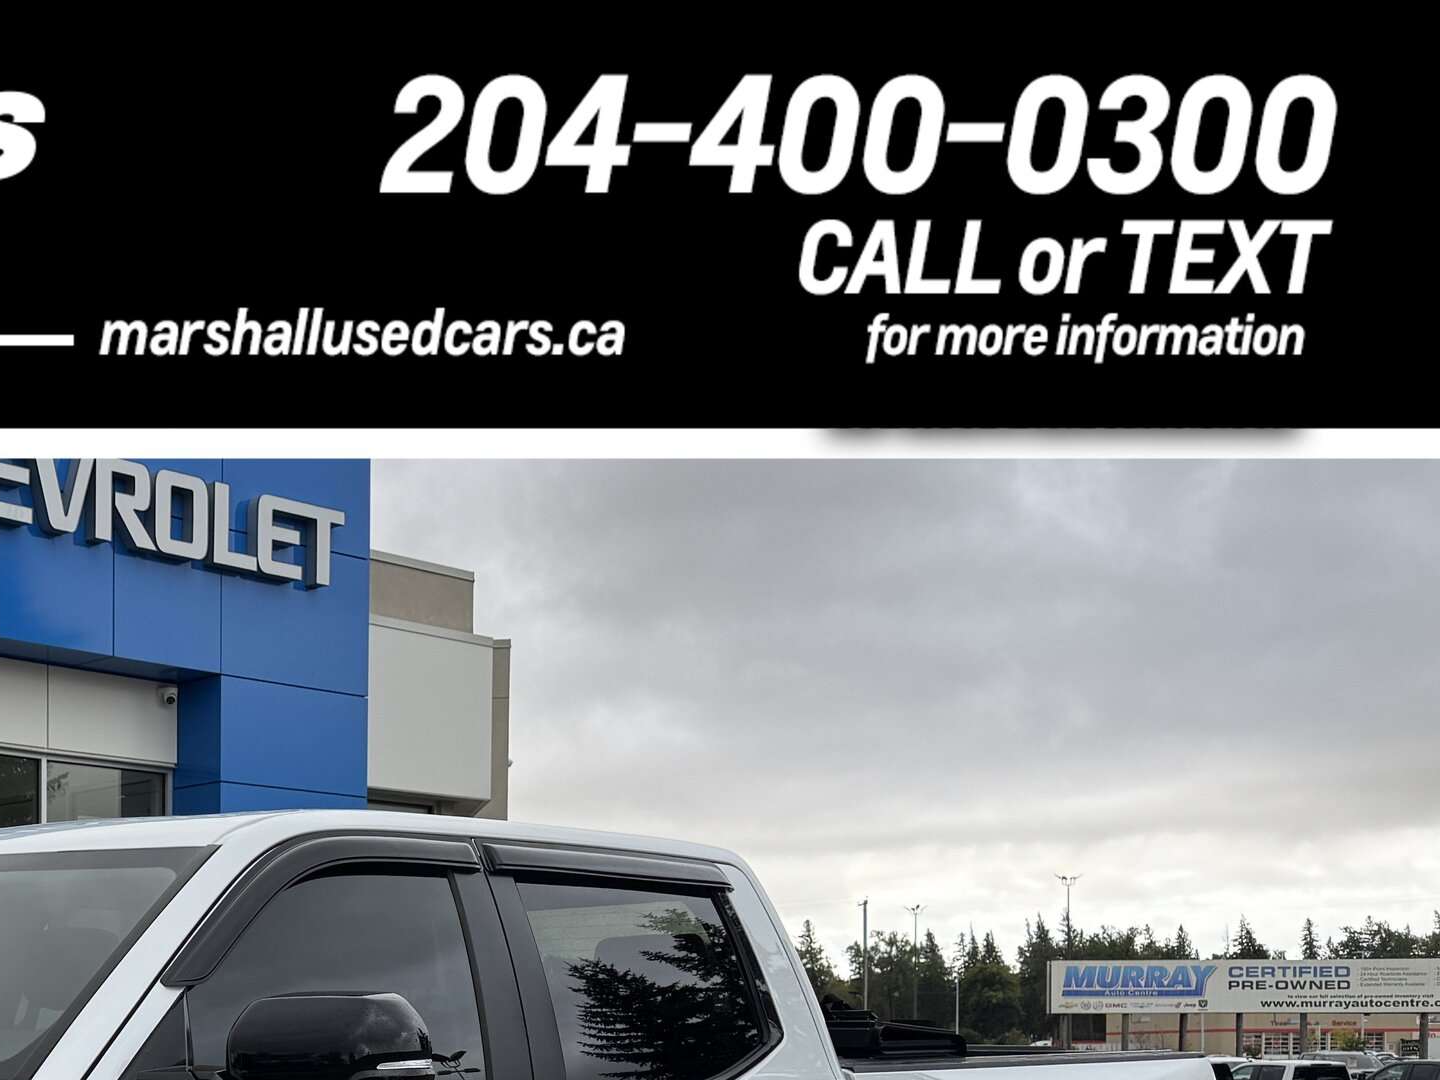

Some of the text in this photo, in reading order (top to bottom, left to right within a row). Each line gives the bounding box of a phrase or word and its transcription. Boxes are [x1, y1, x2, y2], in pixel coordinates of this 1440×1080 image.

[1228, 966, 1351, 978] CERTIFIED
[1062, 965, 1218, 995] MURRAY
[1228, 980, 1351, 990] PRE-OWNED
